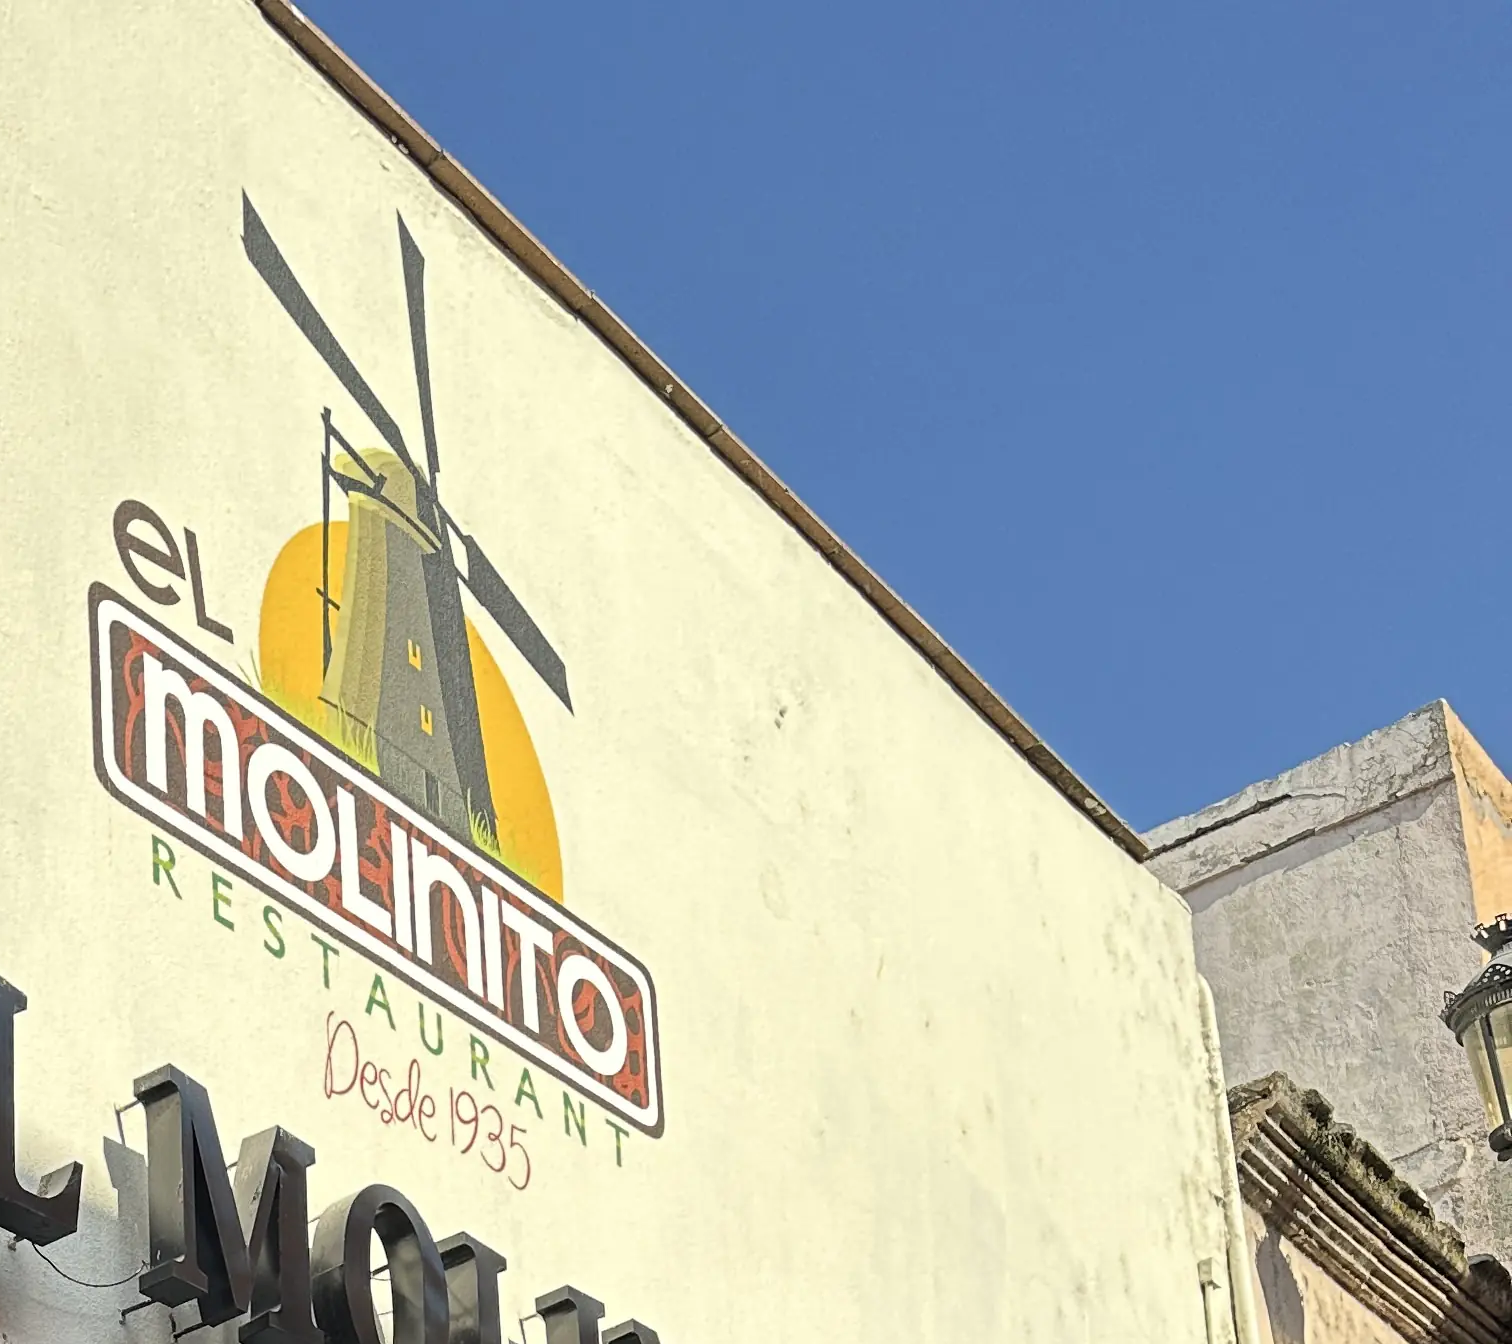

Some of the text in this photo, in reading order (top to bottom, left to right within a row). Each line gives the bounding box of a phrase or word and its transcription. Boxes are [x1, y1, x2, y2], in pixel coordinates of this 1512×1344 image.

[151, 834, 630, 1168] RESTAURANT
[323, 1010, 533, 1191] Desde 1935
